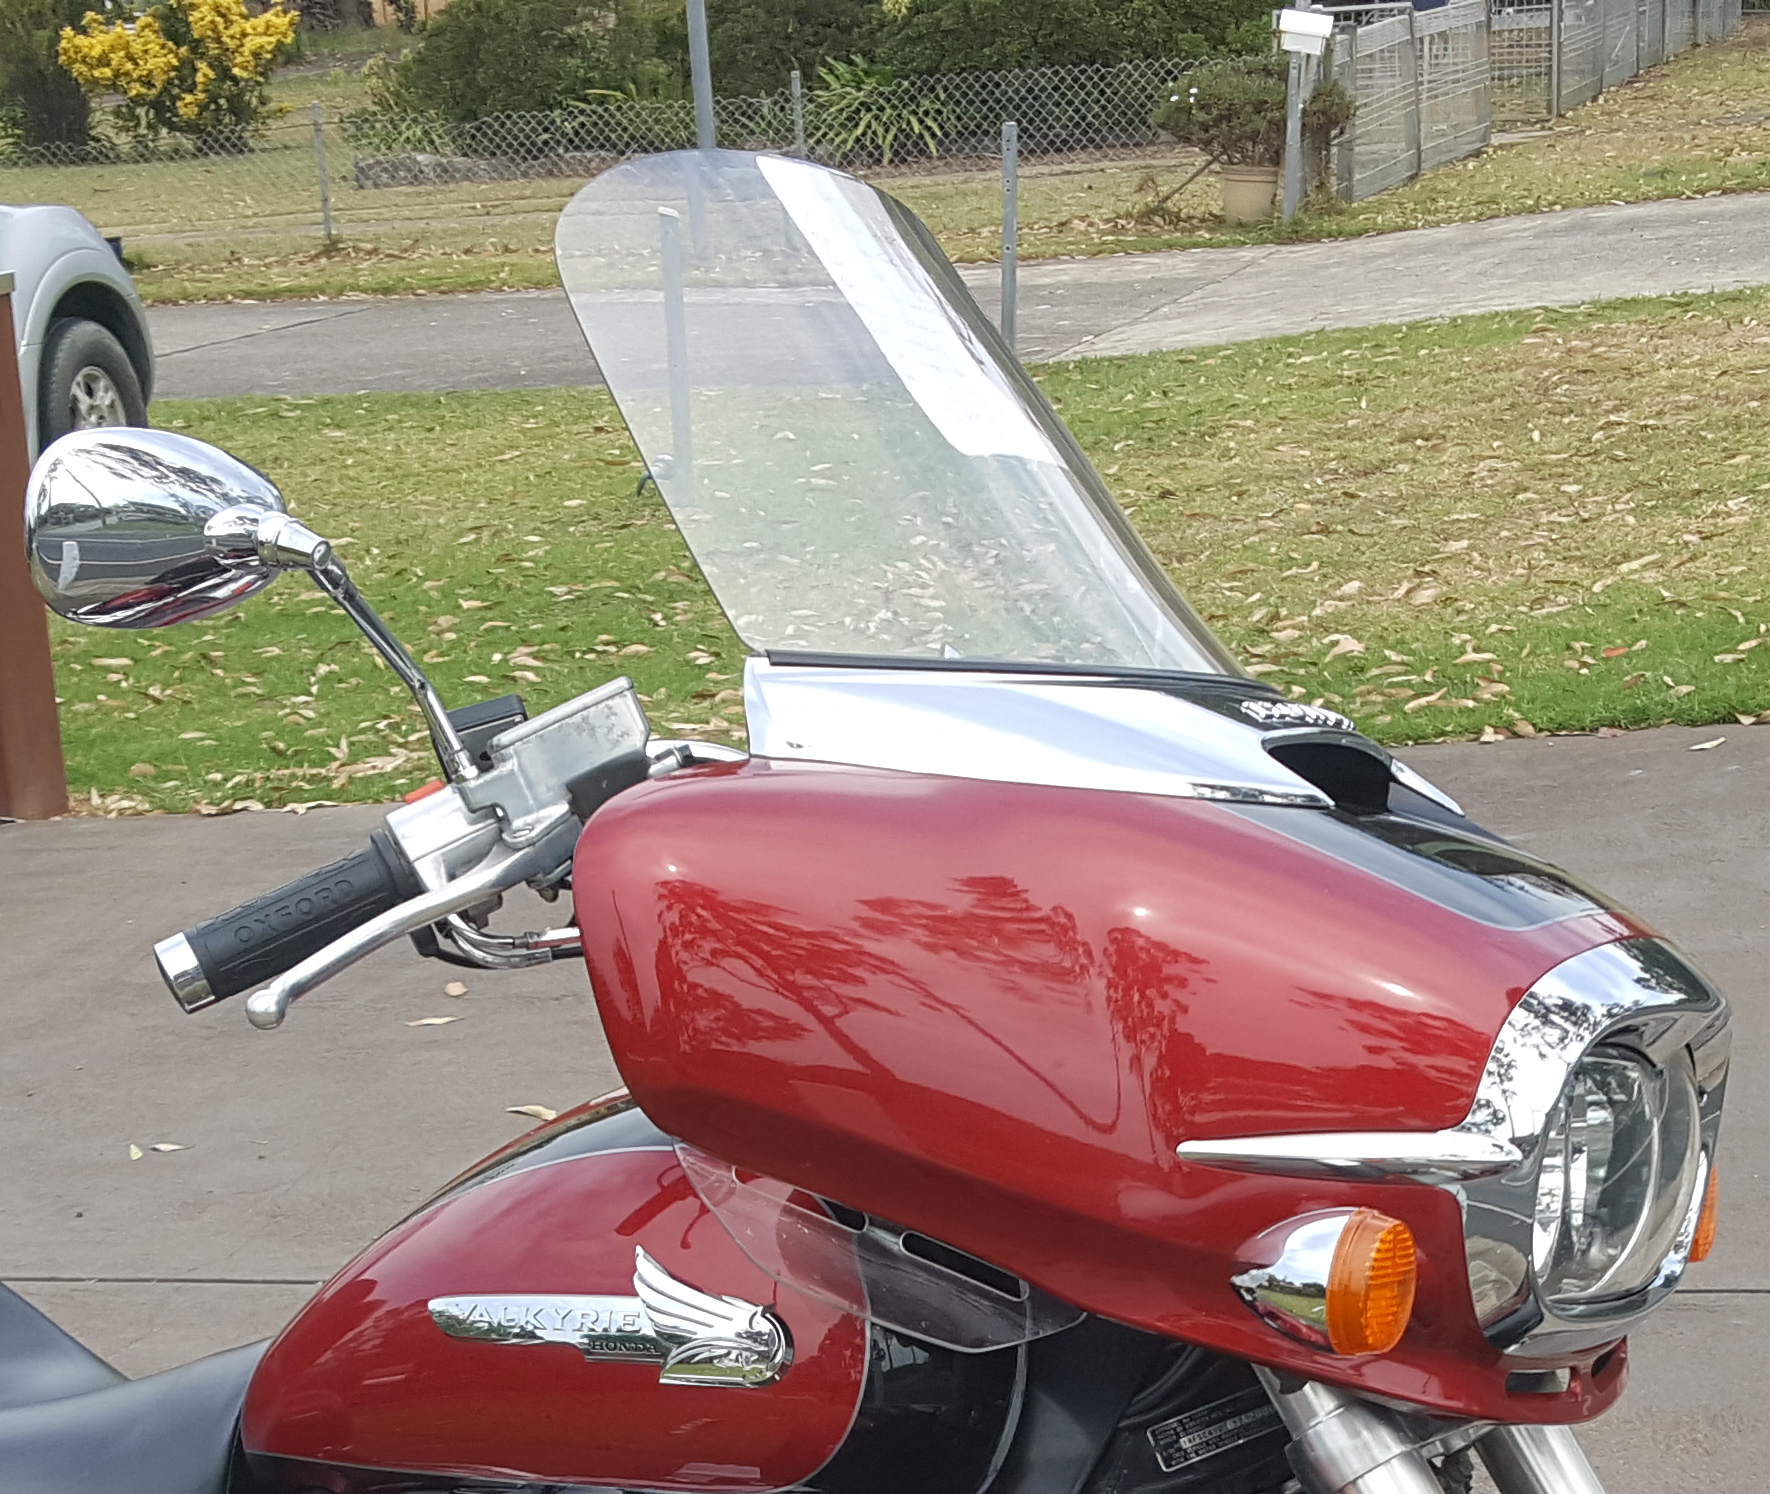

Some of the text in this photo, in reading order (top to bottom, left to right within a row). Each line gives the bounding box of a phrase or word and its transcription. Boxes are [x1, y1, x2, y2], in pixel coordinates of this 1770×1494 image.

[234, 879, 353, 943] OXFORD
[451, 1302, 641, 1333] VALKYRIE
[589, 1341, 660, 1355] HONDA
